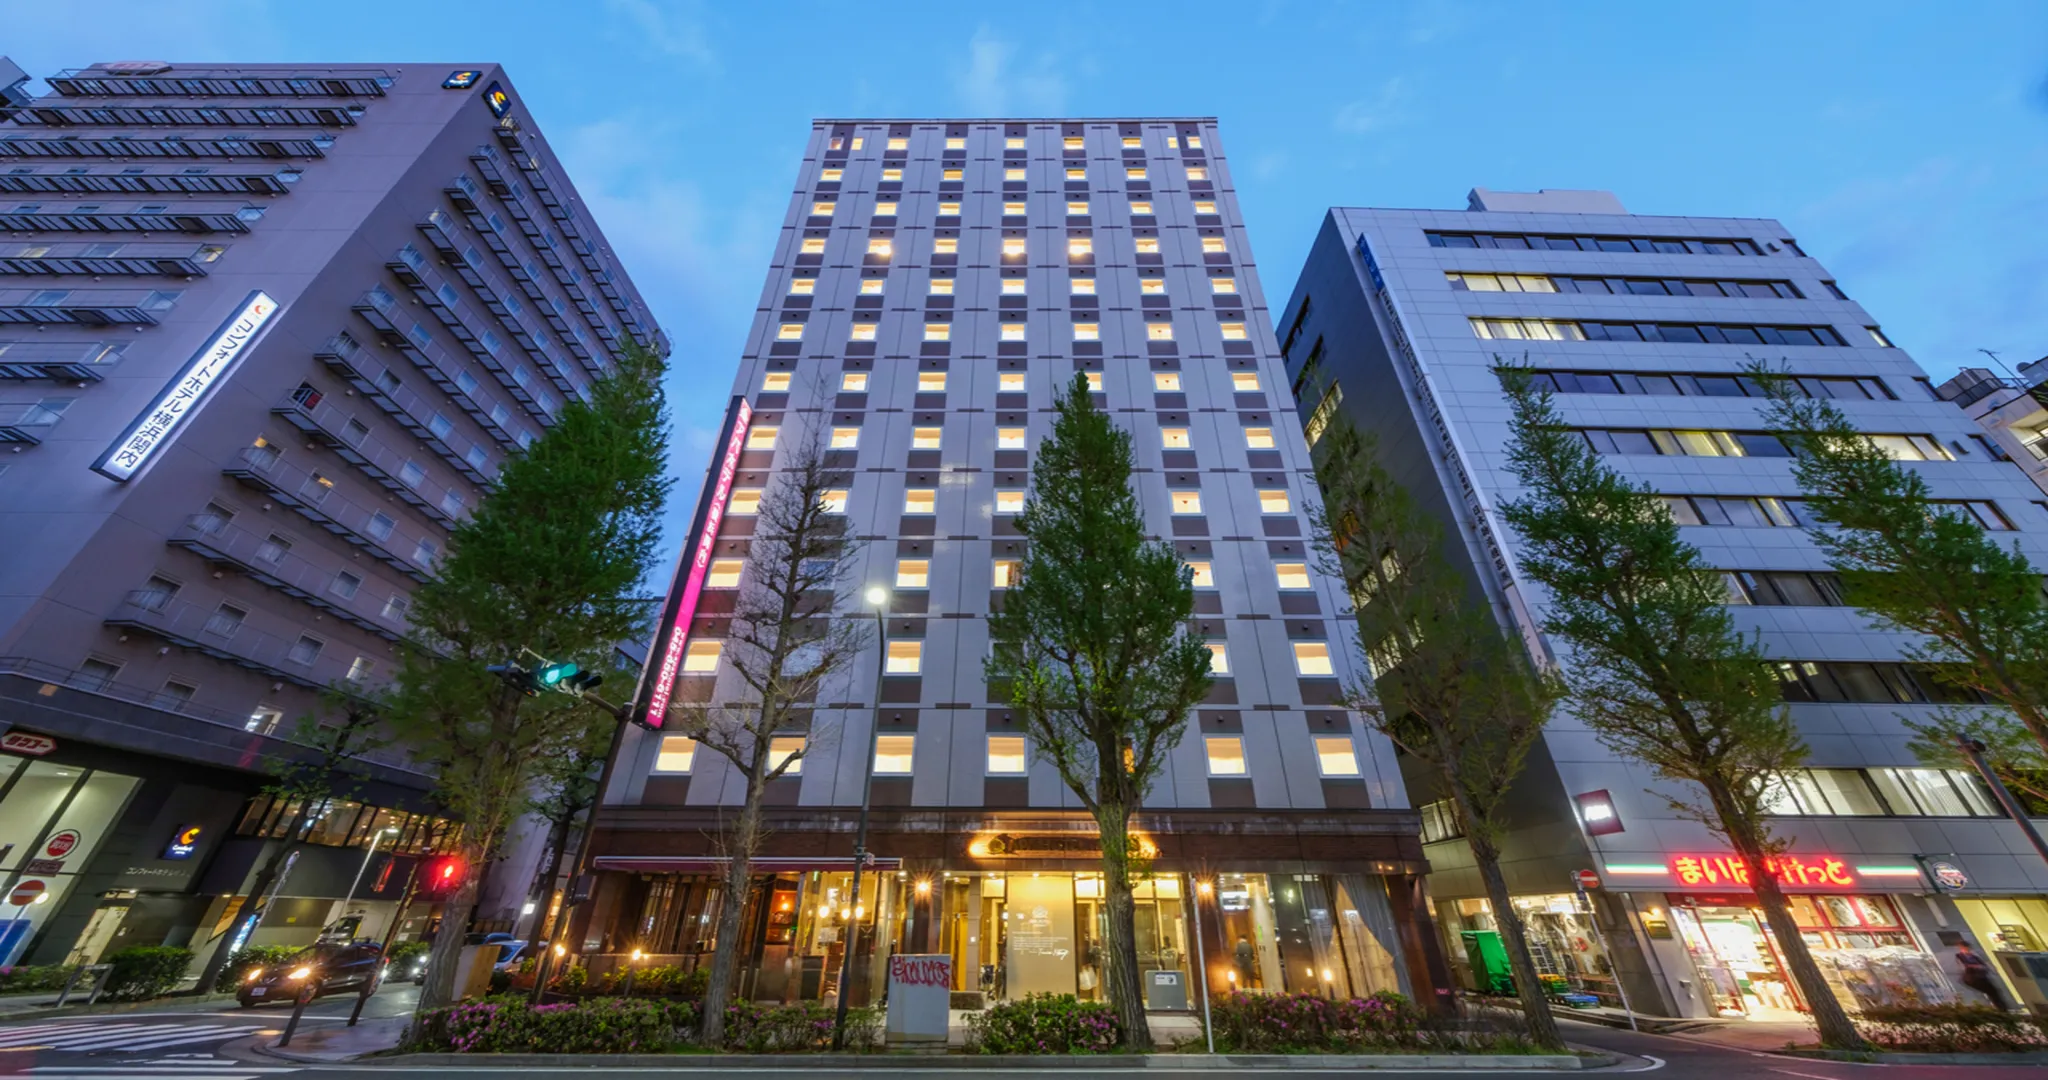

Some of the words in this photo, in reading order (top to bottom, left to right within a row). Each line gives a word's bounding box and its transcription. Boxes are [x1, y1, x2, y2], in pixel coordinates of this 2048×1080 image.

[113, 318, 255, 469] コンフォートホテル横浜関内
[1675, 856, 1853, 886] まいばけっと
